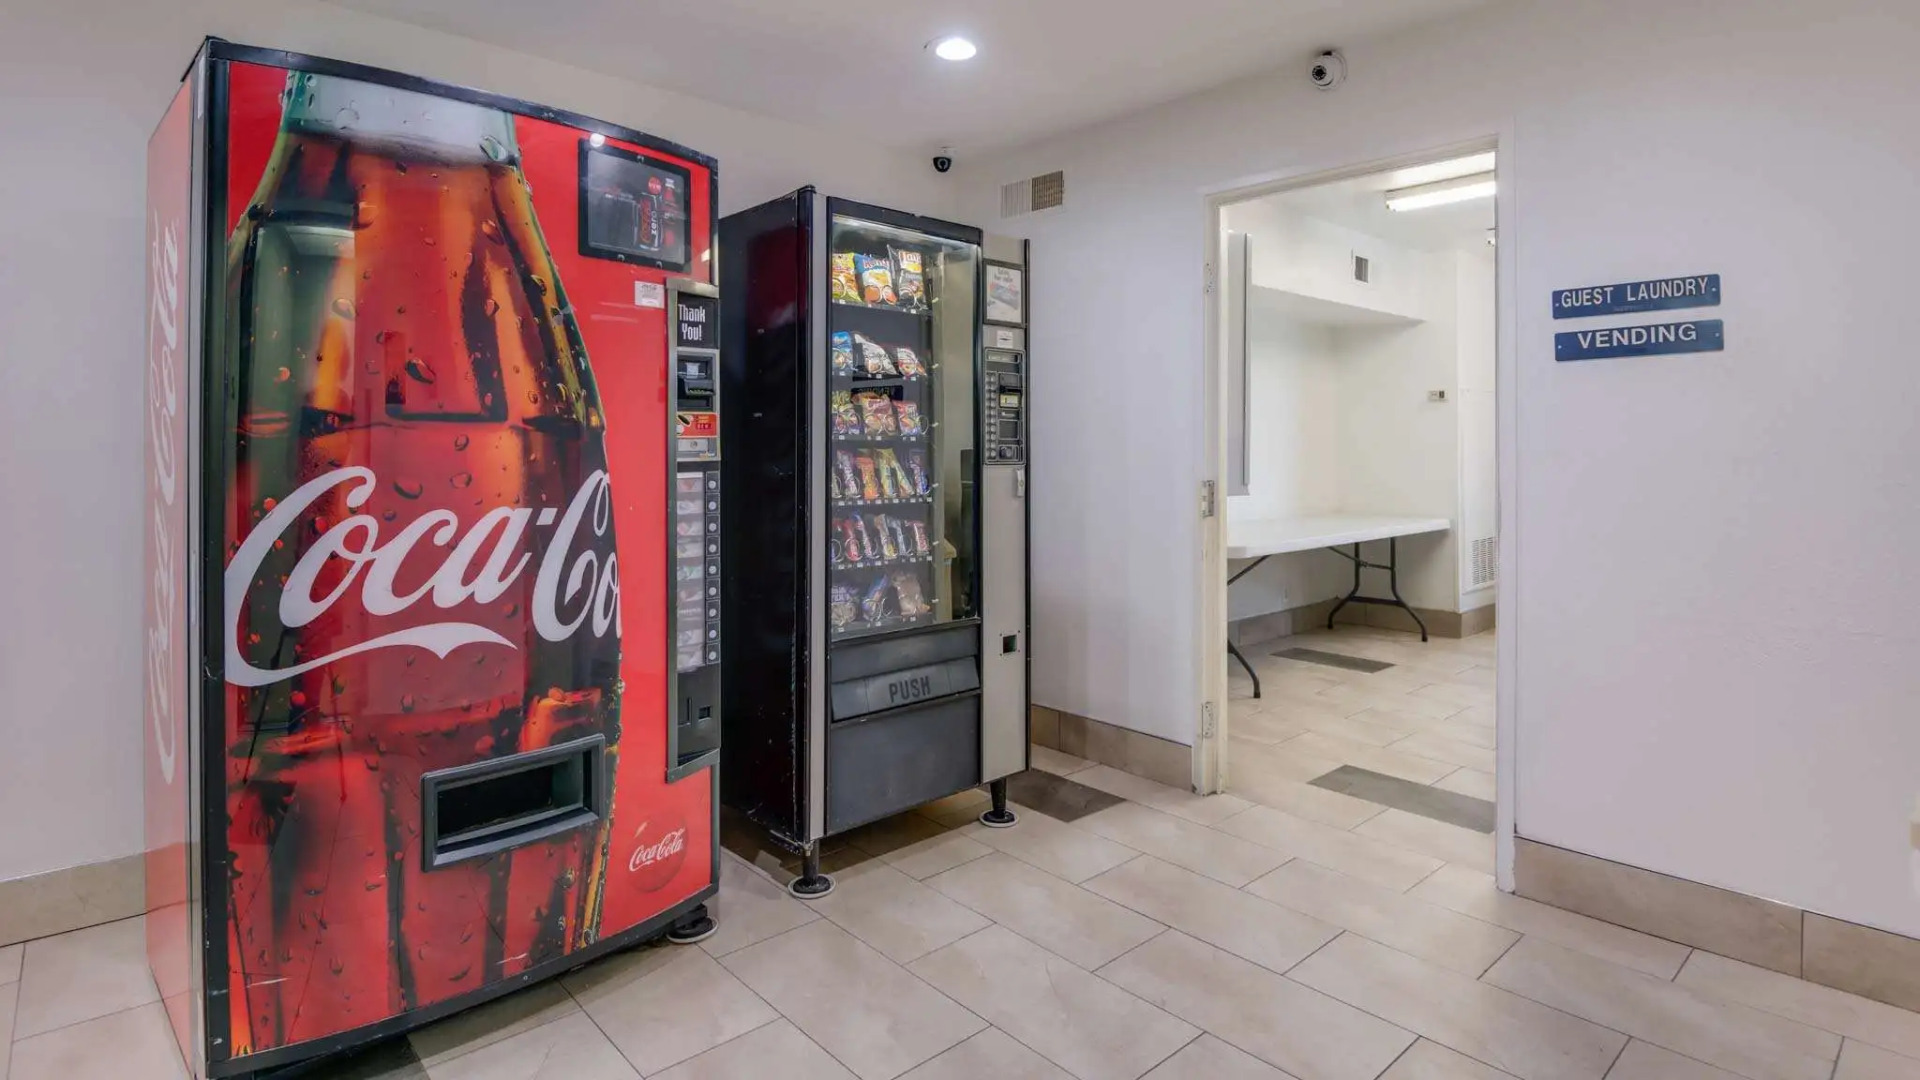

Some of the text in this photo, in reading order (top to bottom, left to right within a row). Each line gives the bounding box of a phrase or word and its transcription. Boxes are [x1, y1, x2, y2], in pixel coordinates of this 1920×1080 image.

[1561, 277, 1708, 308] GUEST LAUNDRY
[678, 303, 706, 323] Thank
[681, 322, 702, 341] You!
[1577, 323, 1697, 349] VENDING
[224, 466, 623, 687] Coca-Co
[888, 675, 931, 703] PUSH
[628, 827, 686, 872] Coca-Cola
